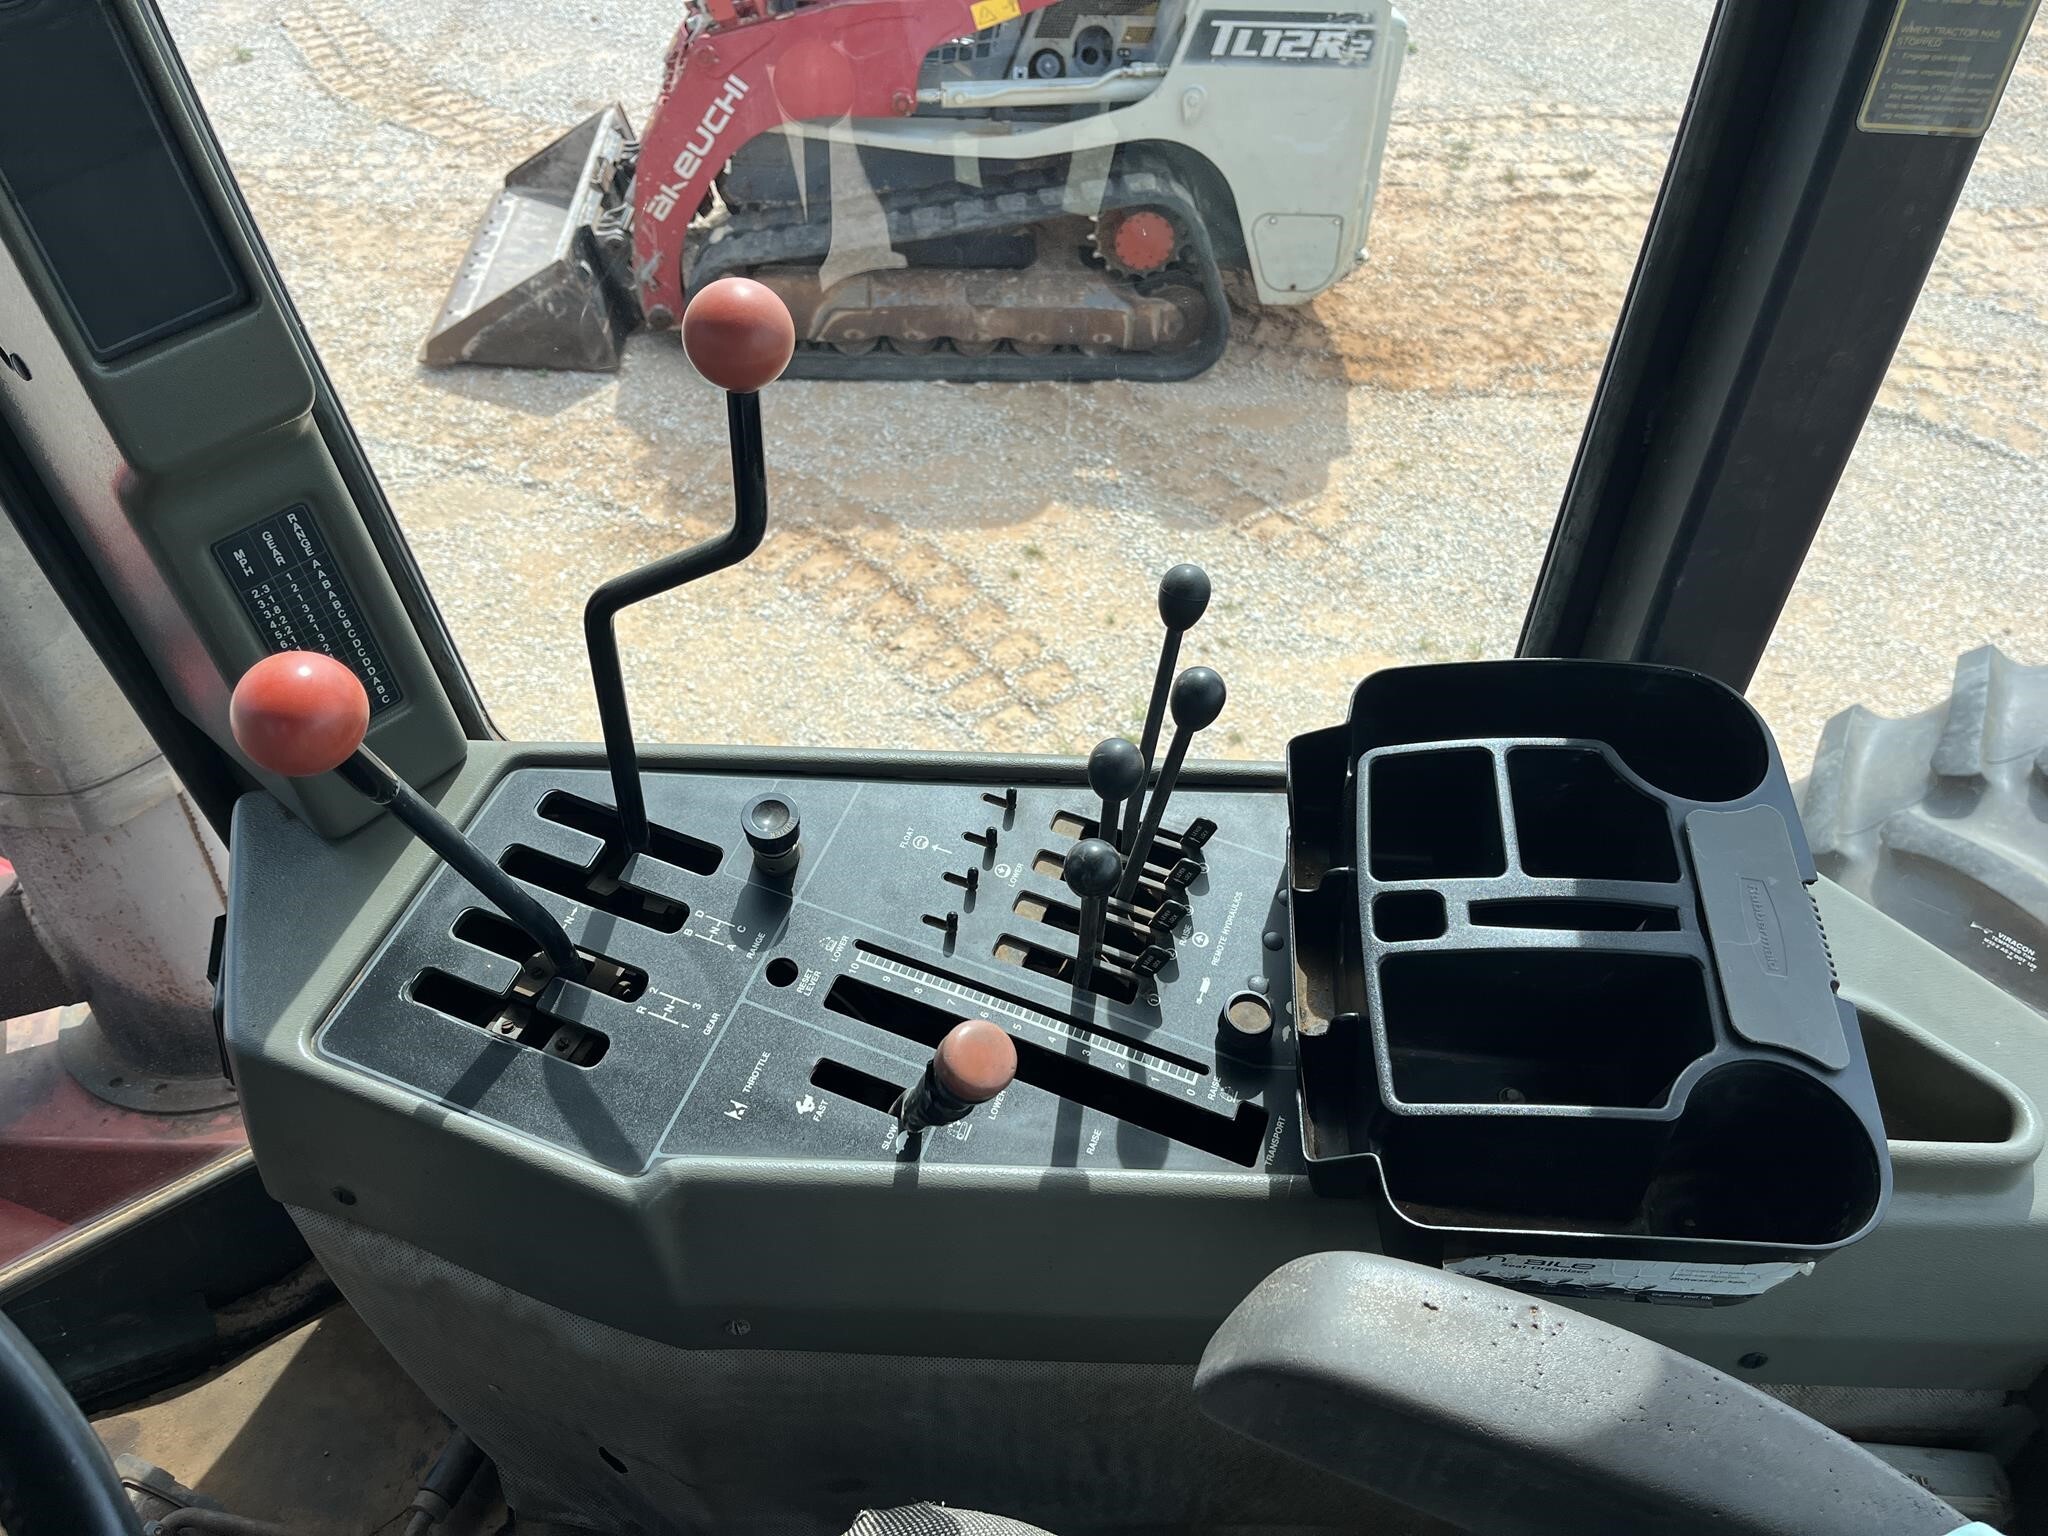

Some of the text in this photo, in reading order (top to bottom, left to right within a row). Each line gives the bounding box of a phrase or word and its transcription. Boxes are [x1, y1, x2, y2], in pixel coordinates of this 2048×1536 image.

[287, 513, 314, 557] RANGE
[262, 531, 286, 566] GEAR
[233, 548, 254, 577] MPH
[252, 585, 270, 598] 2.3
[313, 560, 320, 568] A
[258, 570, 326, 608] 3.1 2 A
[264, 606, 281, 619] 3.8
[322, 580, 331, 589] B
[270, 591, 336, 628] 4.2 3 A
[275, 600, 341, 639] 5.2 2 B
[280, 636, 296, 648] 6.1
[338, 610, 346, 618] C
[342, 620, 351, 628] B
[348, 629, 356, 638] C
[352, 639, 361, 648] D
[358, 648, 366, 657] C
[362, 658, 371, 666] D
[367, 667, 376, 676] D
[373, 677, 381, 685] A
[377, 686, 385, 694] B
[382, 695, 390, 703] C
[899, 827, 915, 849] FLOAT
[1008, 863, 1024, 888] LOWER
[695, 910, 705, 918] D
[683, 925, 746, 937] B N C
[1179, 924, 1193, 946] RAISE
[1211, 891, 1243, 967] REMOTE HYDRAULICS
[726, 943, 737, 952] A
[746, 931, 766, 959] RANGE
[831, 935, 849, 963] LOWER
[1998, 932, 2036, 956] VIRACON
[649, 986, 659, 995] 2
[796, 967, 814, 994] RESET
[803, 970, 821, 997] LEVER
[636, 1006, 647, 1014] R
[664, 1004, 675, 1013] N
[703, 1012, 721, 1036] GEAR
[848, 963, 860, 975] 10
[882, 975, 891, 983] 9
[914, 987, 923, 995] 8
[980, 1011, 989, 1019] 6
[1013, 1023, 1022, 1032] 5
[1047, 1036, 1056, 1044] 4
[1116, 1062, 1125, 1070] 2
[1187, 1088, 1196, 1096] 0
[742, 1051, 771, 1093] THROTTLE
[1207, 1075, 1222, 1101] RAISE
[813, 1099, 829, 1122] FAST
[882, 1123, 898, 1150] SLOW
[1086, 1128, 1102, 1155] RAISE
[1264, 1115, 1286, 1166] TRANSPORT
